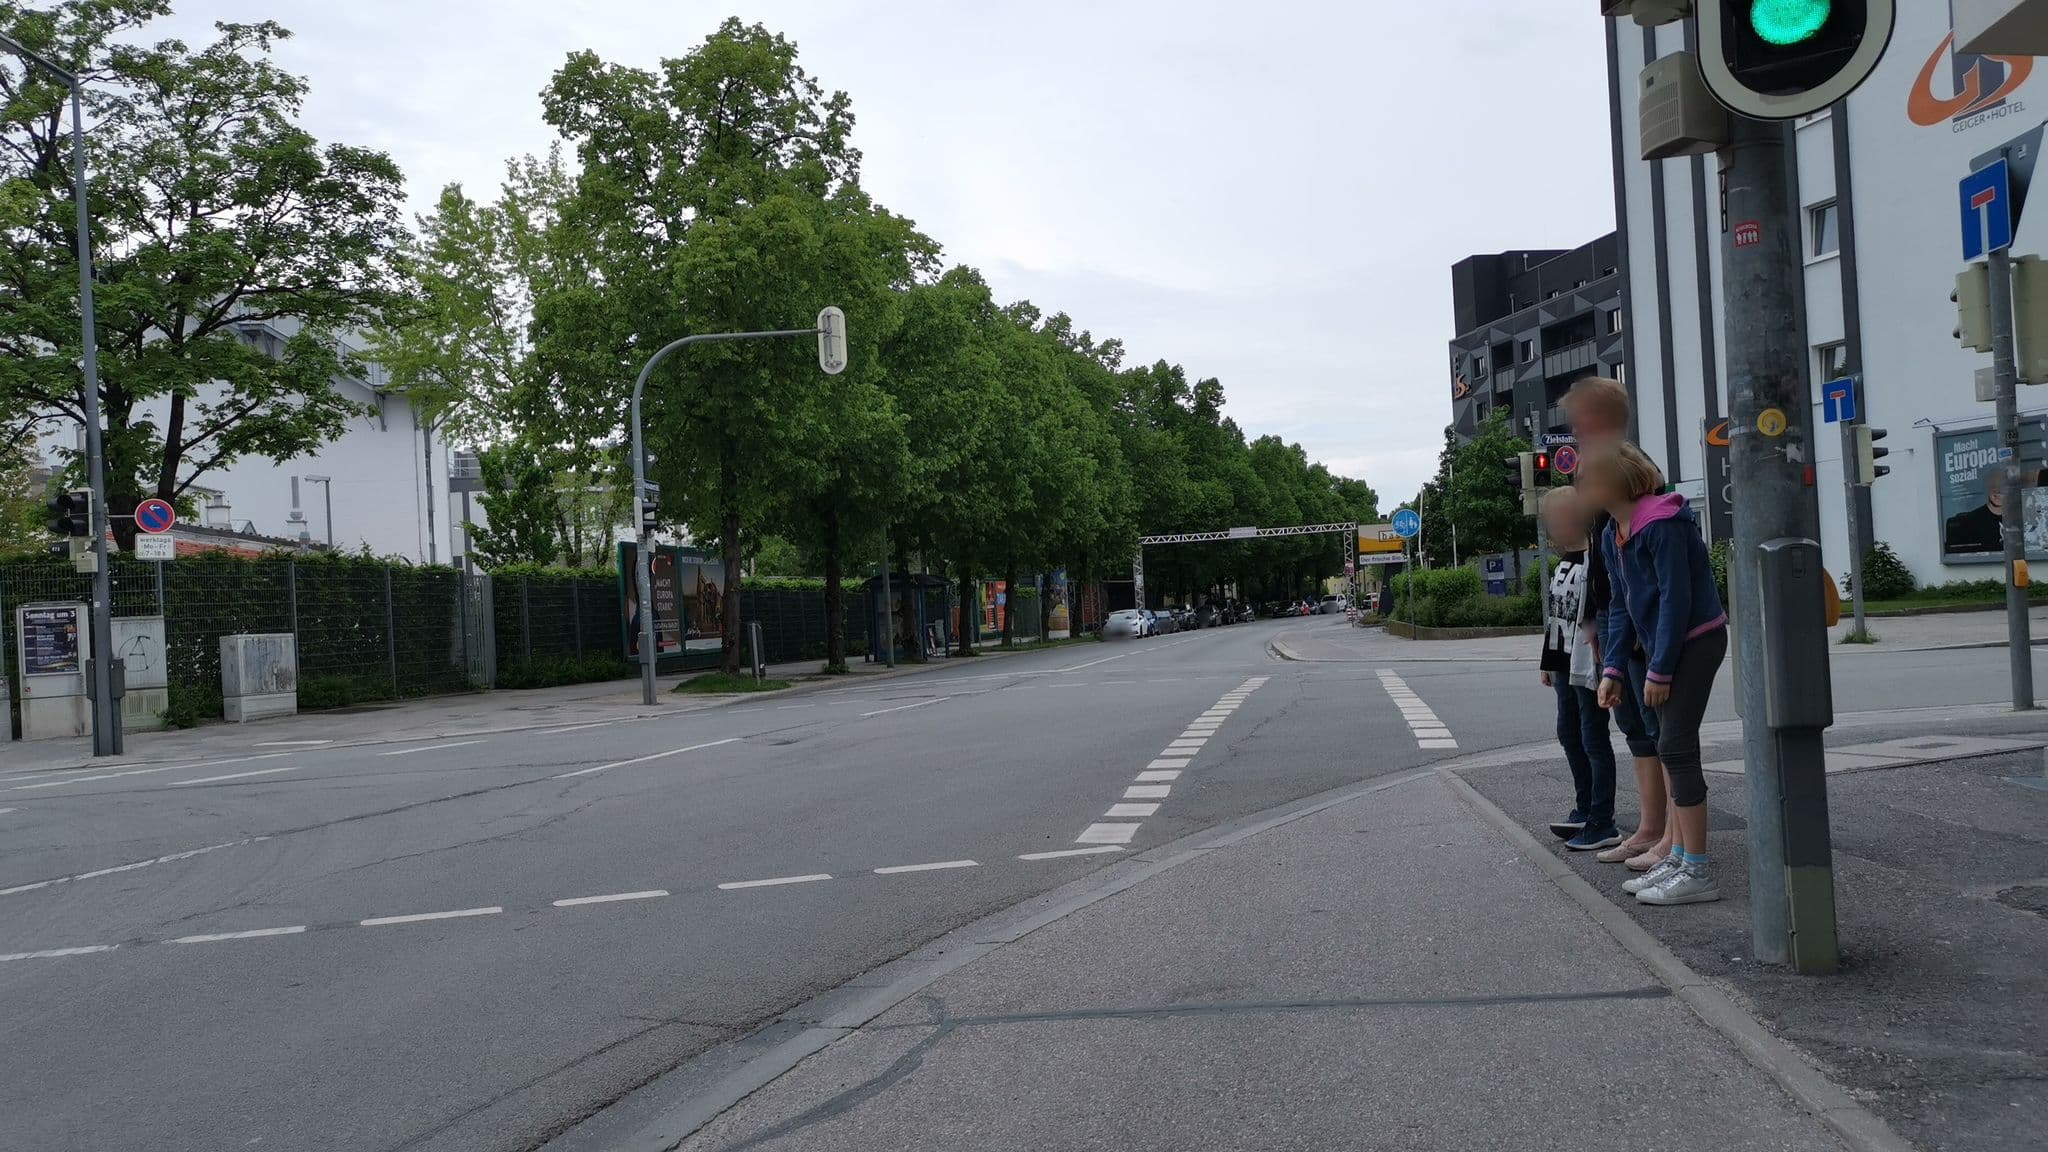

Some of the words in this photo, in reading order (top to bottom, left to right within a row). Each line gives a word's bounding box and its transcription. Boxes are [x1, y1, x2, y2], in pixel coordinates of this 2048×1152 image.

[1952, 113, 1987, 134] GEIGER
[1991, 101, 2026, 121] HOTEL
[1953, 438, 1978, 454] Macht
[1944, 447, 1998, 473] Europa
[656, 590, 674, 600] EUROPA
[25, 611, 55, 620] Sonntag
[69, 610, 76, 618] 3
